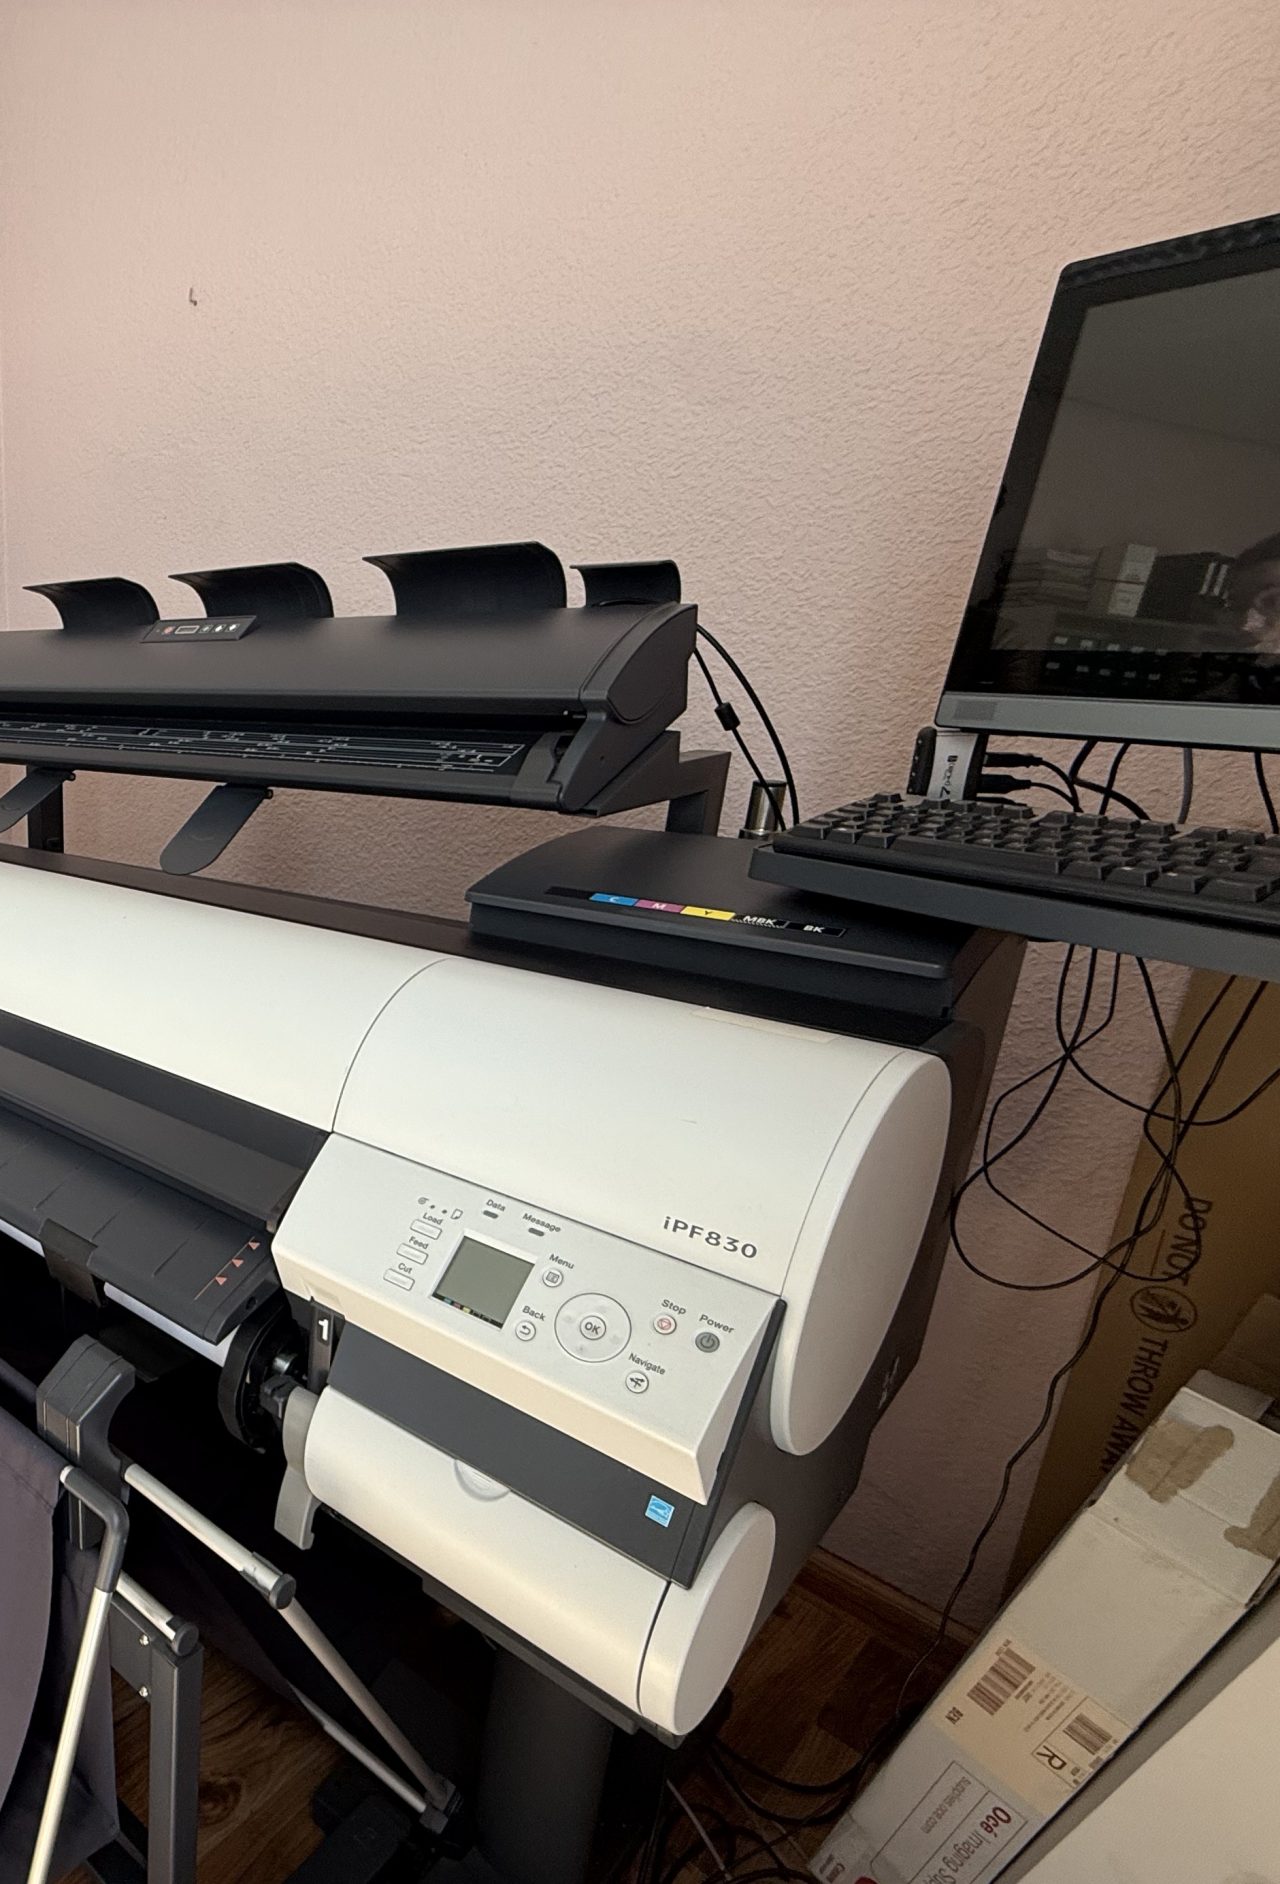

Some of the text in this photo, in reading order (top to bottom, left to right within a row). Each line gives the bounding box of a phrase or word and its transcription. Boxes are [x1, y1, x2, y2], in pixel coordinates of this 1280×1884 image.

[652, 902, 668, 911] M
[742, 914, 776, 926] MBK
[803, 924, 825, 934] BK
[486, 1199, 506, 1212] Data
[1178, 1196, 1213, 1231] DO
[422, 1212, 444, 1226] Load
[522, 1212, 561, 1232] Message
[408, 1236, 429, 1250] Feed
[662, 1216, 758, 1259] iPF830
[397, 1262, 413, 1275] Cut
[549, 1253, 575, 1270] Menu
[522, 1305, 546, 1322] Back
[661, 1299, 687, 1316] Stop
[584, 1321, 601, 1336] OK
[699, 1313, 735, 1335] Power
[628, 1352, 666, 1376] Navigate
[1119, 1337, 1169, 1417] THROW
[1036, 1745, 1068, 1771] R
[980, 1806, 1012, 1838] Océ
[942, 1829, 991, 1873] Imaging
